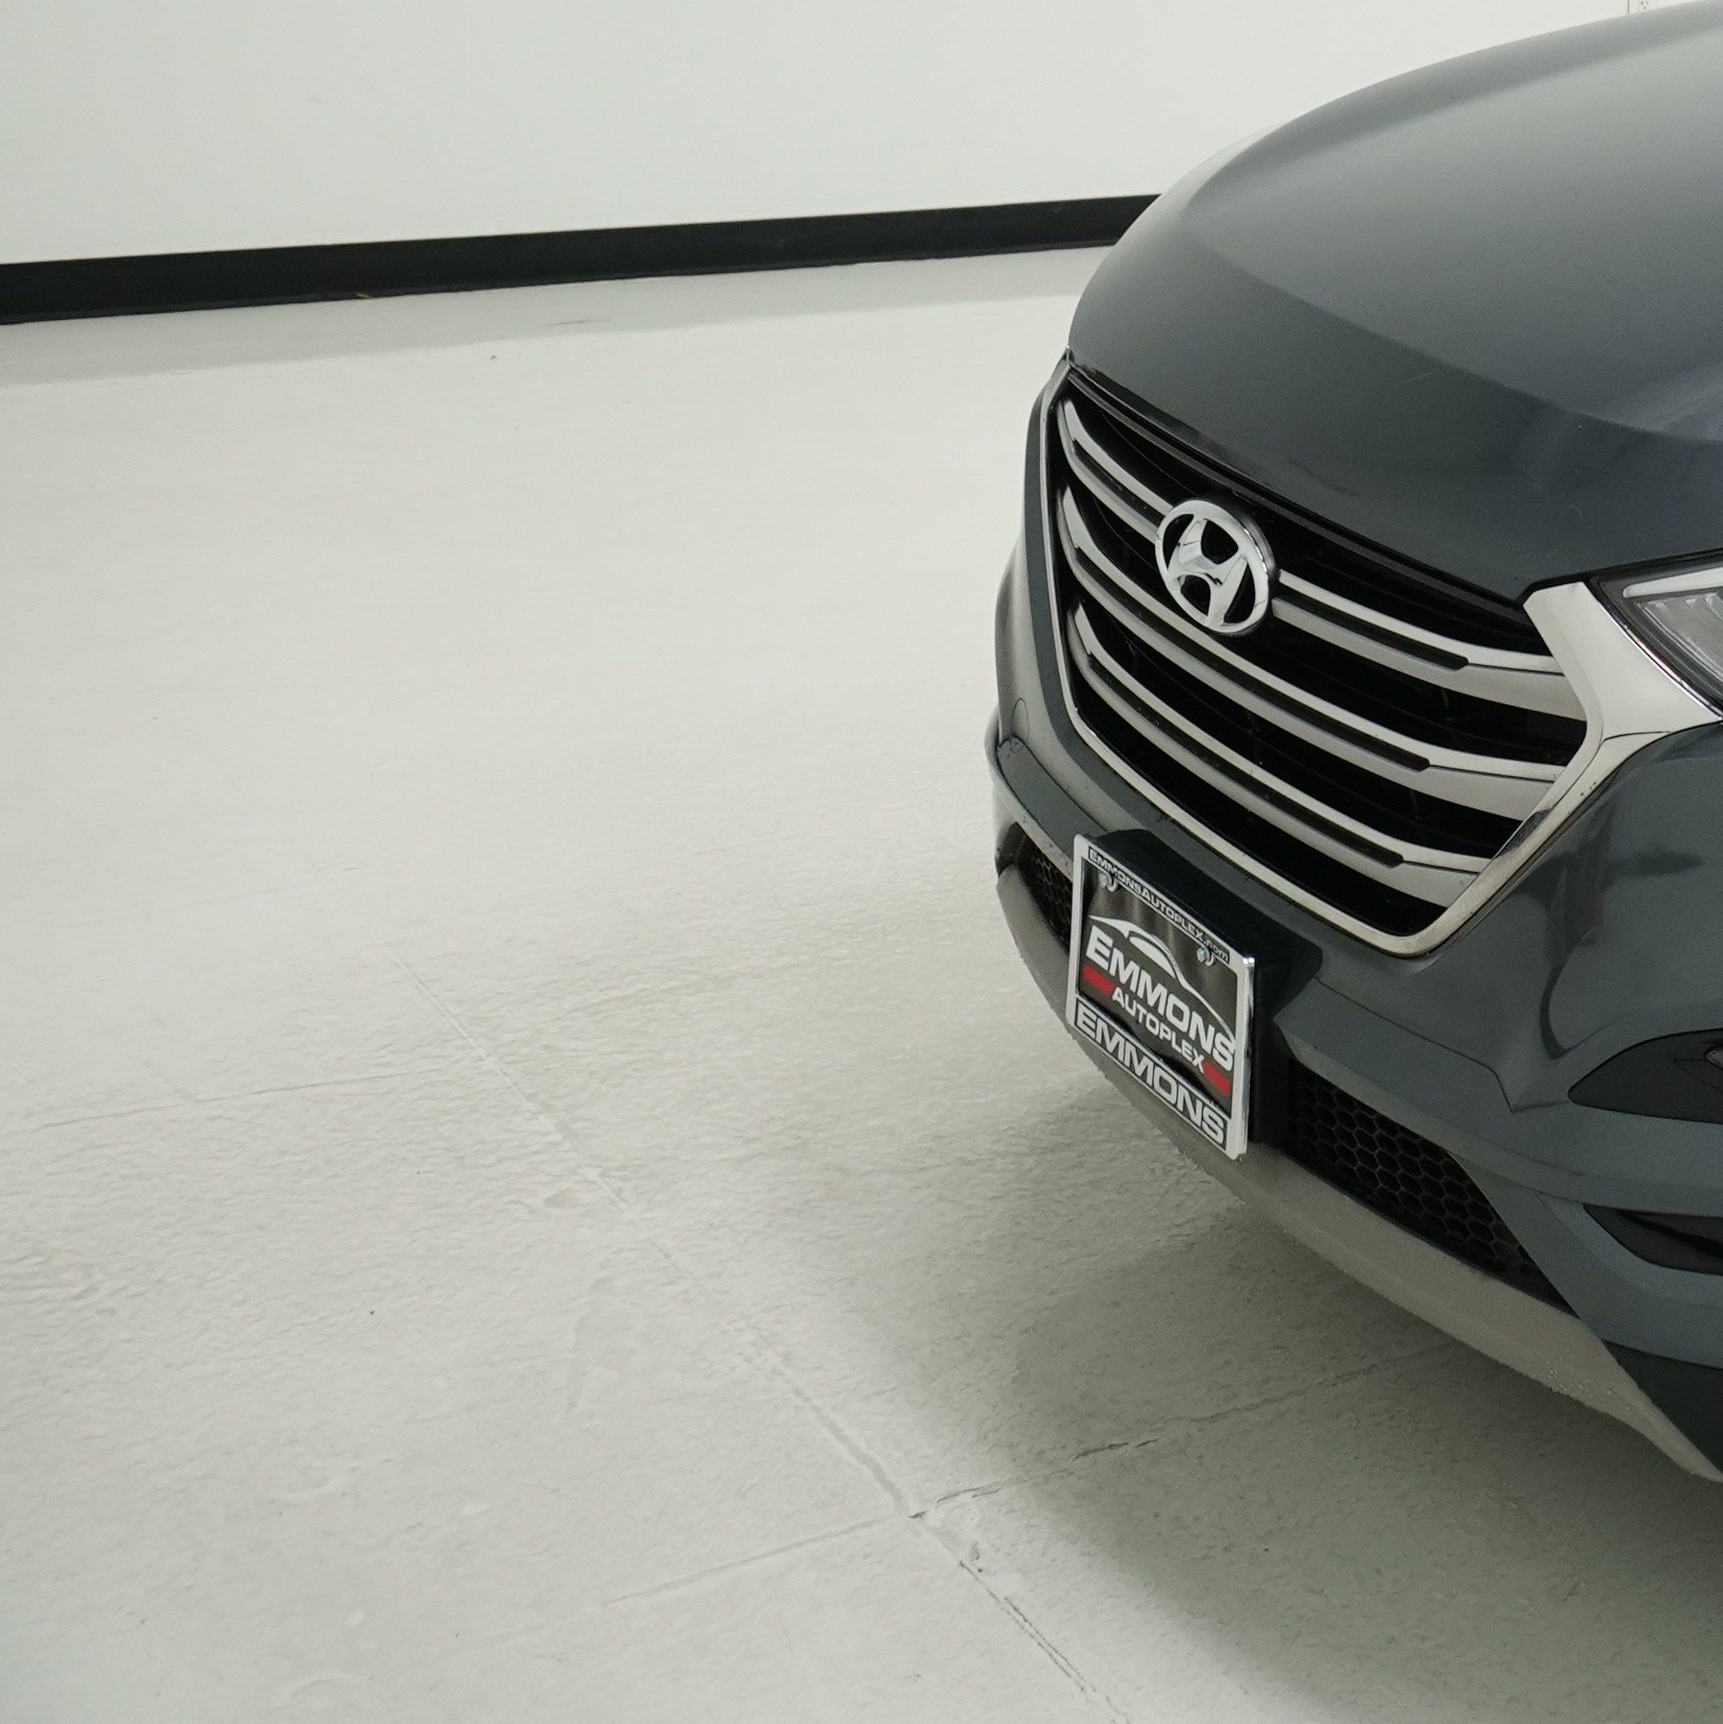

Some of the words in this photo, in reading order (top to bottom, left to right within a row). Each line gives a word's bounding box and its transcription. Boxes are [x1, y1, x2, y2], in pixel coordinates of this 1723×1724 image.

[1086, 925, 1235, 1072] EMMONS
[1111, 987, 1206, 1074] AUTOPLEX
[1077, 1007, 1226, 1146] EMMONS
